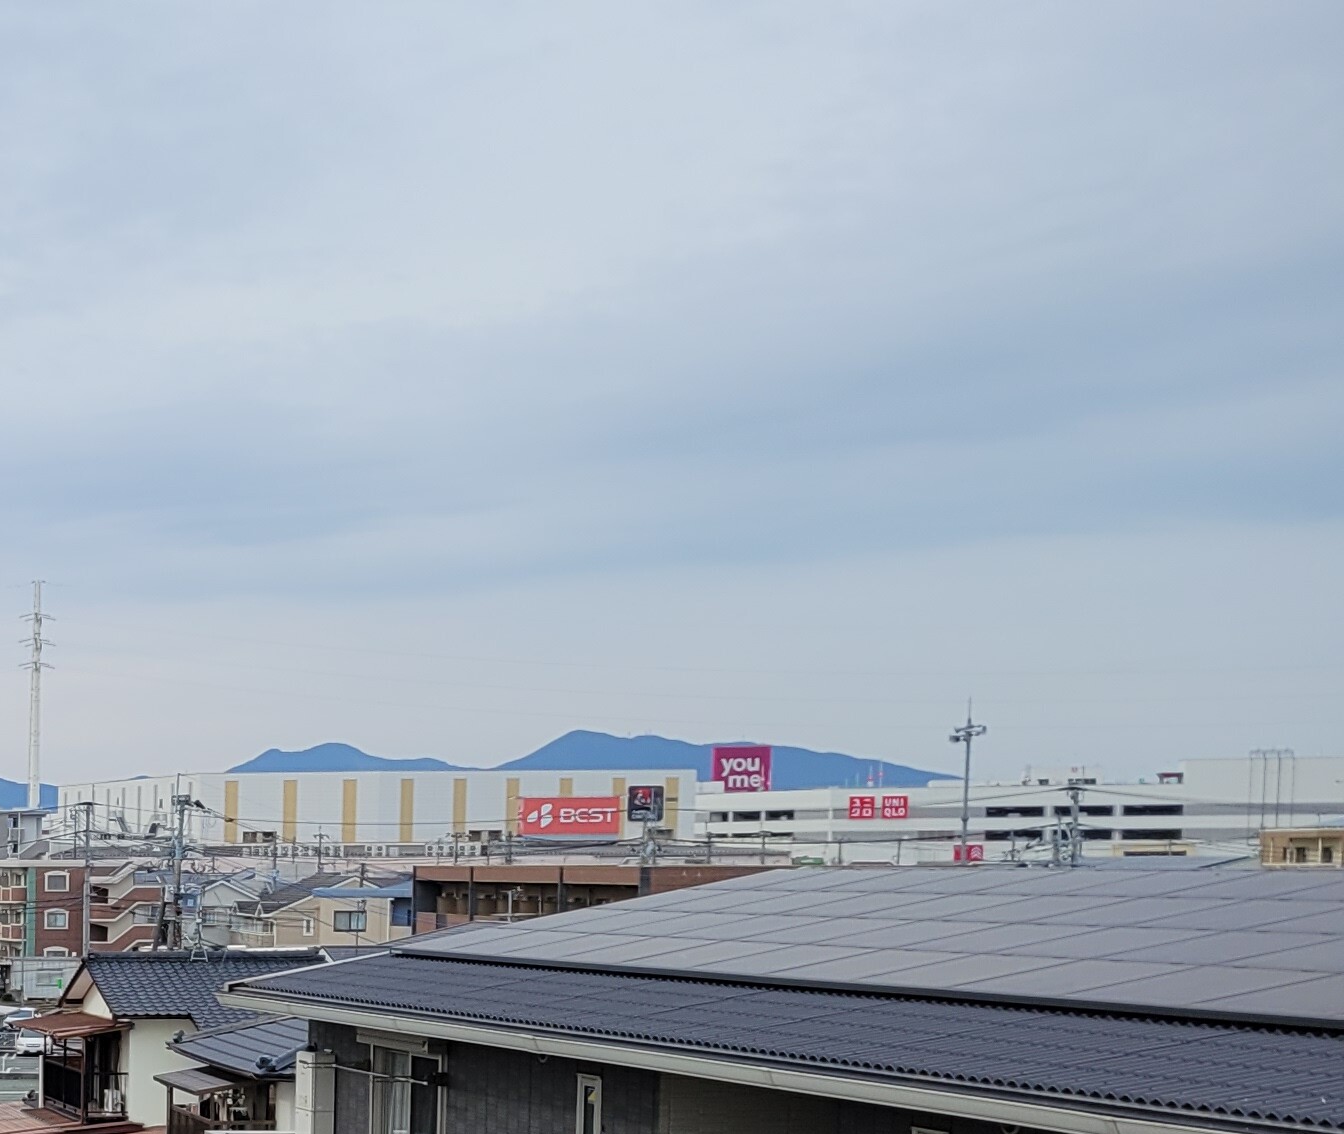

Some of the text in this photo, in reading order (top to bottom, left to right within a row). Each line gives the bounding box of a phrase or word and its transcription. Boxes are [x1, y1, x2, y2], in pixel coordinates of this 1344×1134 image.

[720, 757, 761, 777] you
[727, 772, 762, 788] me
[884, 798, 906, 808] UNI
[559, 807, 618, 823] BEST
[883, 807, 906, 818] QLO
